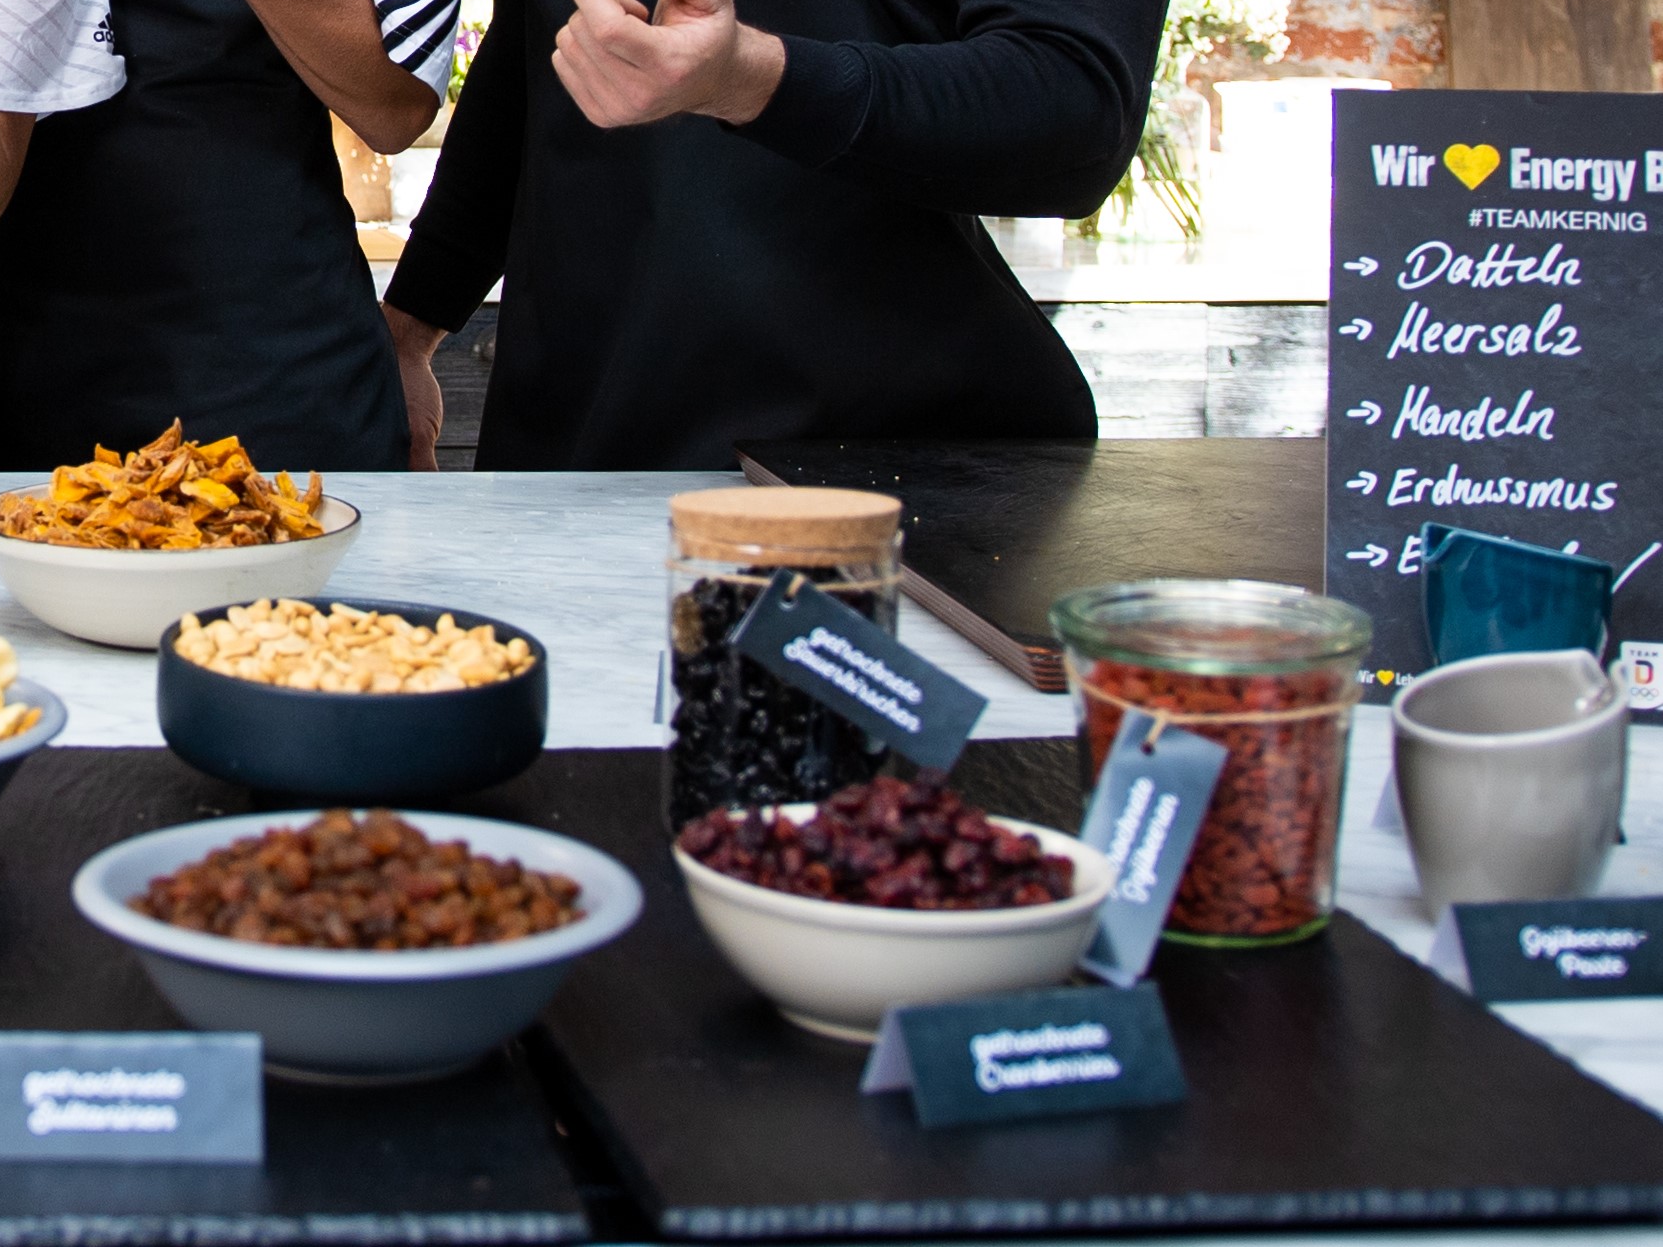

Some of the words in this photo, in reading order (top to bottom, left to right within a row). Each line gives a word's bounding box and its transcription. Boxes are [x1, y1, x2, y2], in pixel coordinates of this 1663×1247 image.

[1371, 143, 1435, 188] Wir
[1509, 147, 1636, 201] Energy
[1468, 208, 1648, 232] #TEAMKERNIG
[1397, 240, 1582, 290] Datteln
[1387, 300, 1582, 360] Meersalz
[1391, 384, 1555, 442] Mandeln
[1387, 463, 1618, 511] Erdnussmus
[1630, 649, 1658, 657] TEAM
